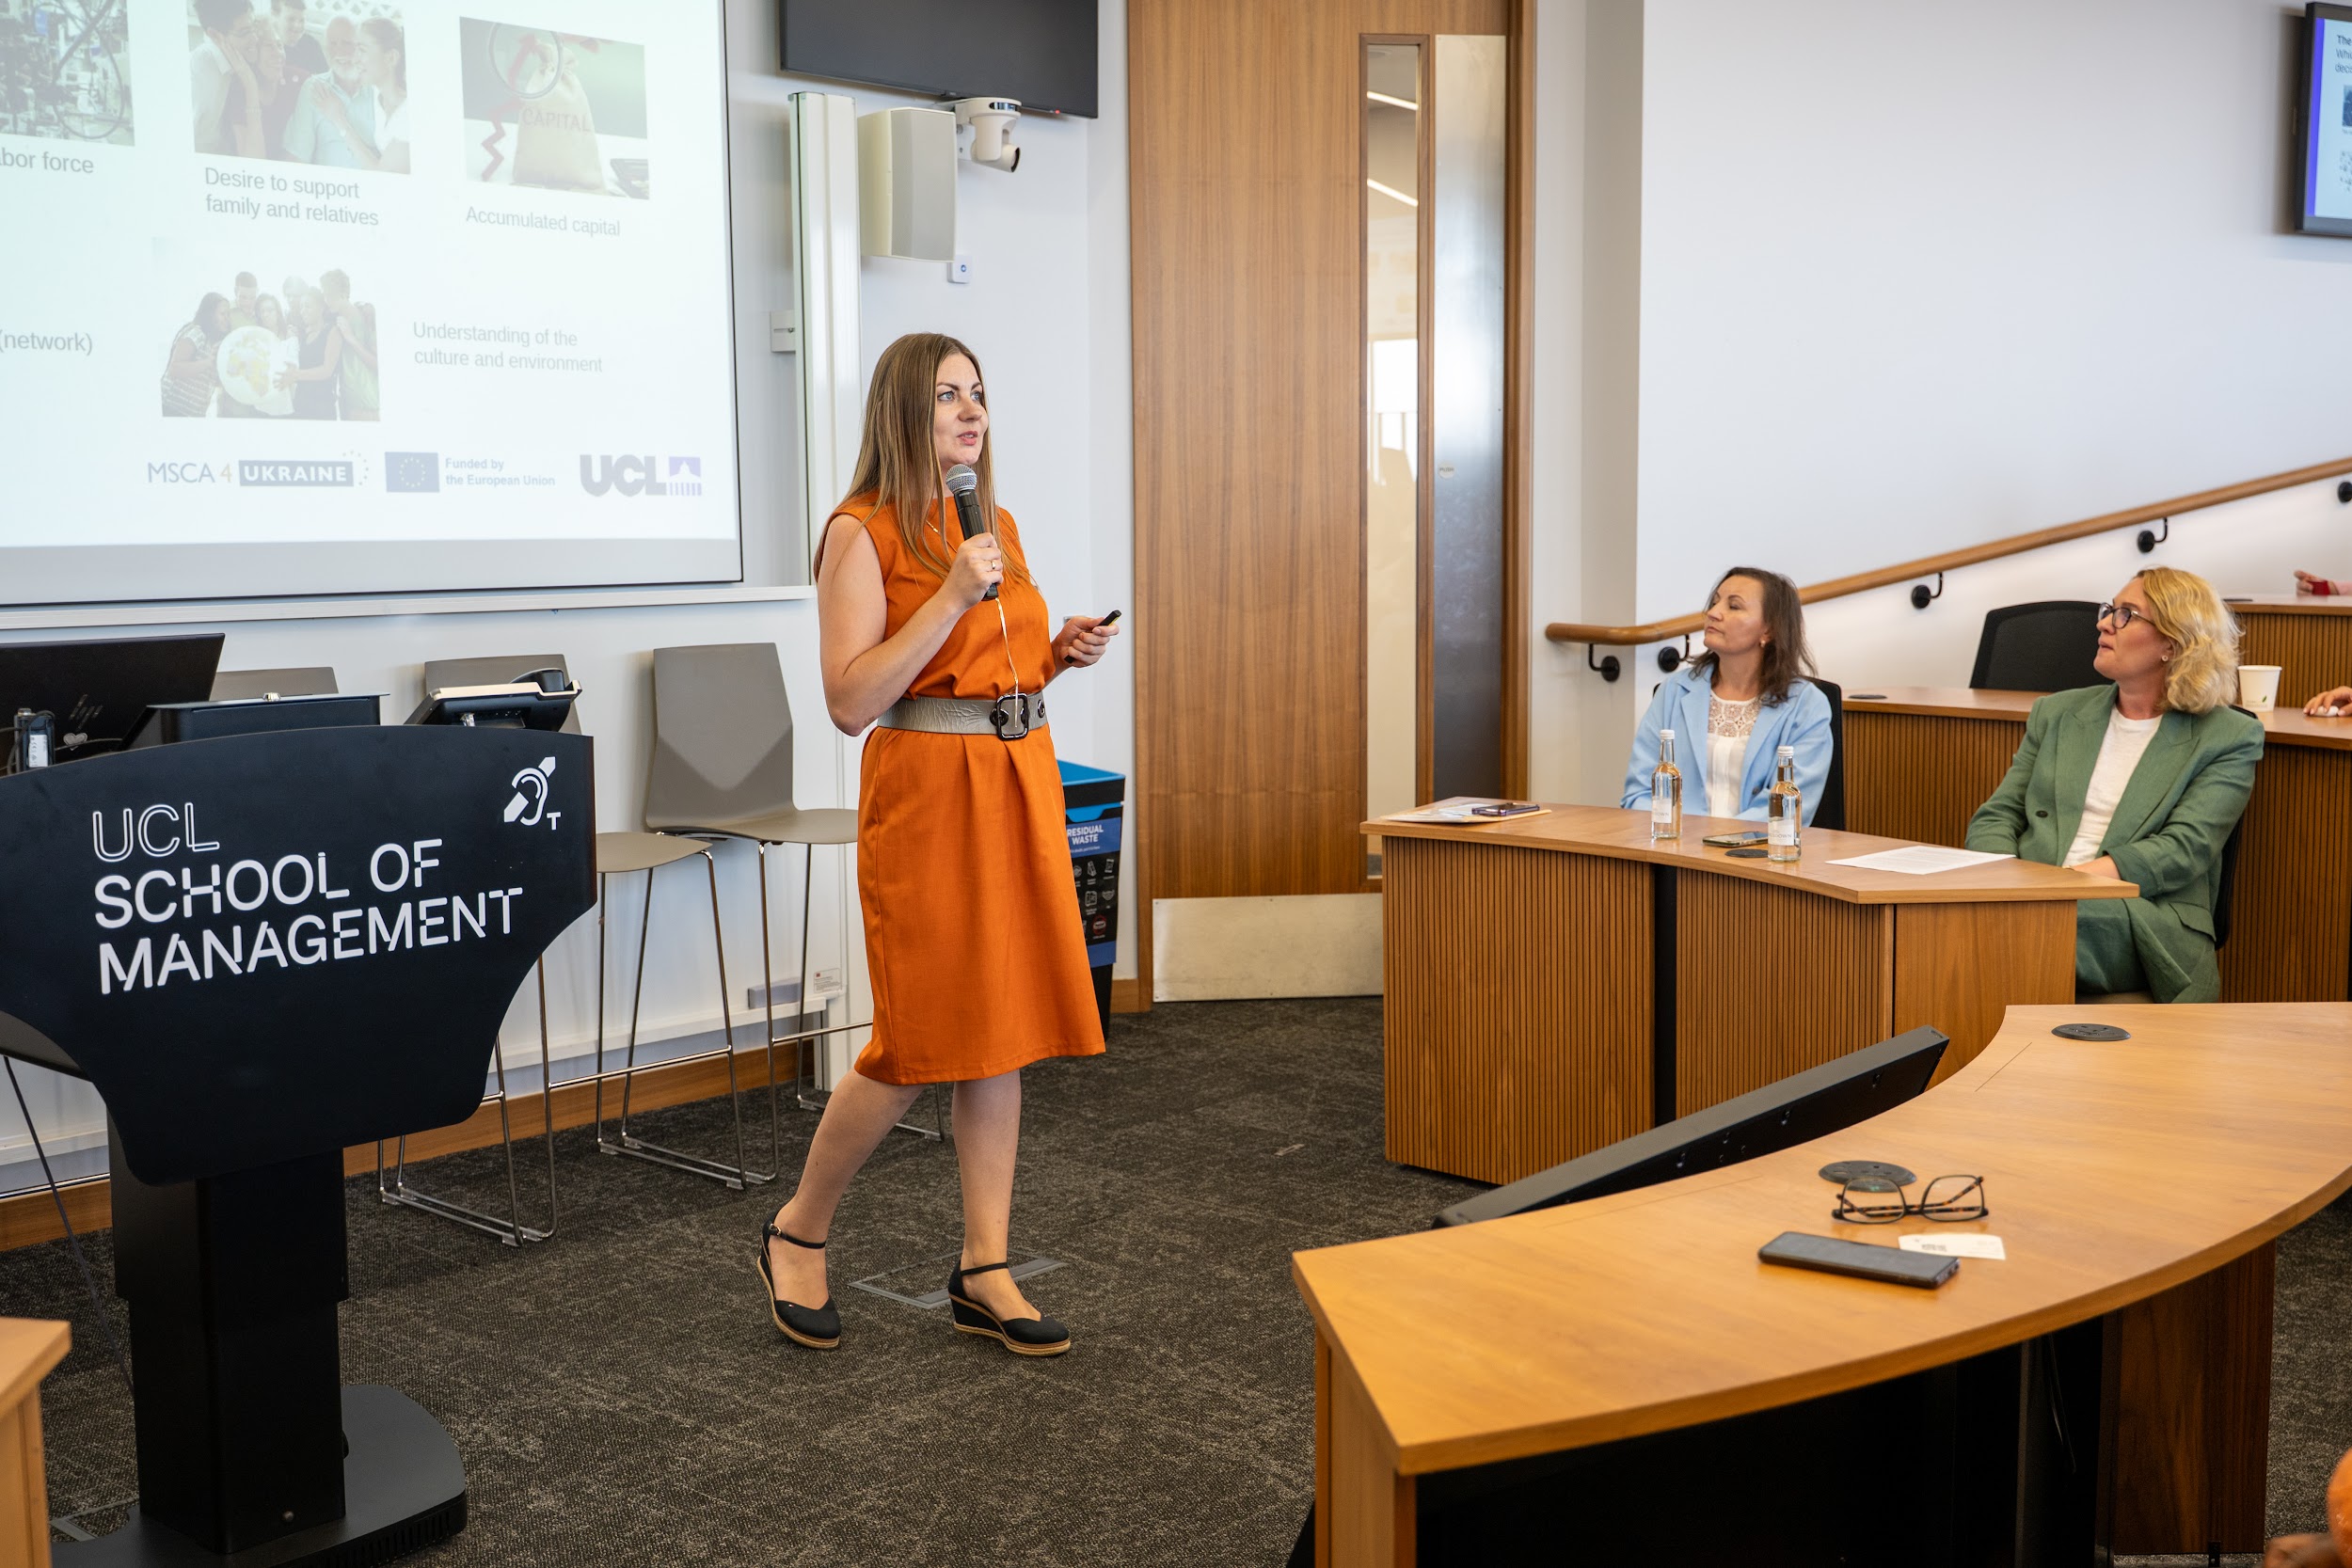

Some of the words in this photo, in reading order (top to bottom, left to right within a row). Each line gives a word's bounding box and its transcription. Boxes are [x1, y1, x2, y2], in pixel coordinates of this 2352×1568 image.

[522, 105, 592, 133] CAPITAL
[0, 147, 36, 168] bor
[42, 150, 94, 174] force
[204, 166, 265, 189] Desire
[271, 175, 287, 192] to
[293, 179, 360, 200] support
[206, 194, 261, 220] family
[266, 201, 300, 219] and
[307, 204, 379, 226] relatives
[466, 205, 567, 231] Accumulated
[572, 219, 621, 237] capital
[413, 322, 531, 348] Understanding
[534, 328, 549, 345] of
[554, 329, 578, 346] the
[414, 348, 469, 366] culture
[474, 352, 504, 368] and
[508, 354, 602, 372] environment
[147, 461, 215, 483] MSCA
[219, 463, 232, 483] 4
[243, 465, 347, 483] UKRAINE
[445, 457, 487, 469] Funded
[490, 458, 504, 472] by
[579, 454, 667, 498] UCL
[445, 474, 463, 485] the
[467, 474, 520, 487] European
[523, 475, 555, 486] Union
[93, 802, 220, 863] UCL
[547, 812, 561, 830] T
[1067, 824, 1104, 837] RESIDUAL
[1071, 833, 1099, 846] WASTE
[94, 851, 350, 929] SCHOOL
[370, 838, 443, 893] OF
[100, 887, 523, 995] MANAGEMENT
